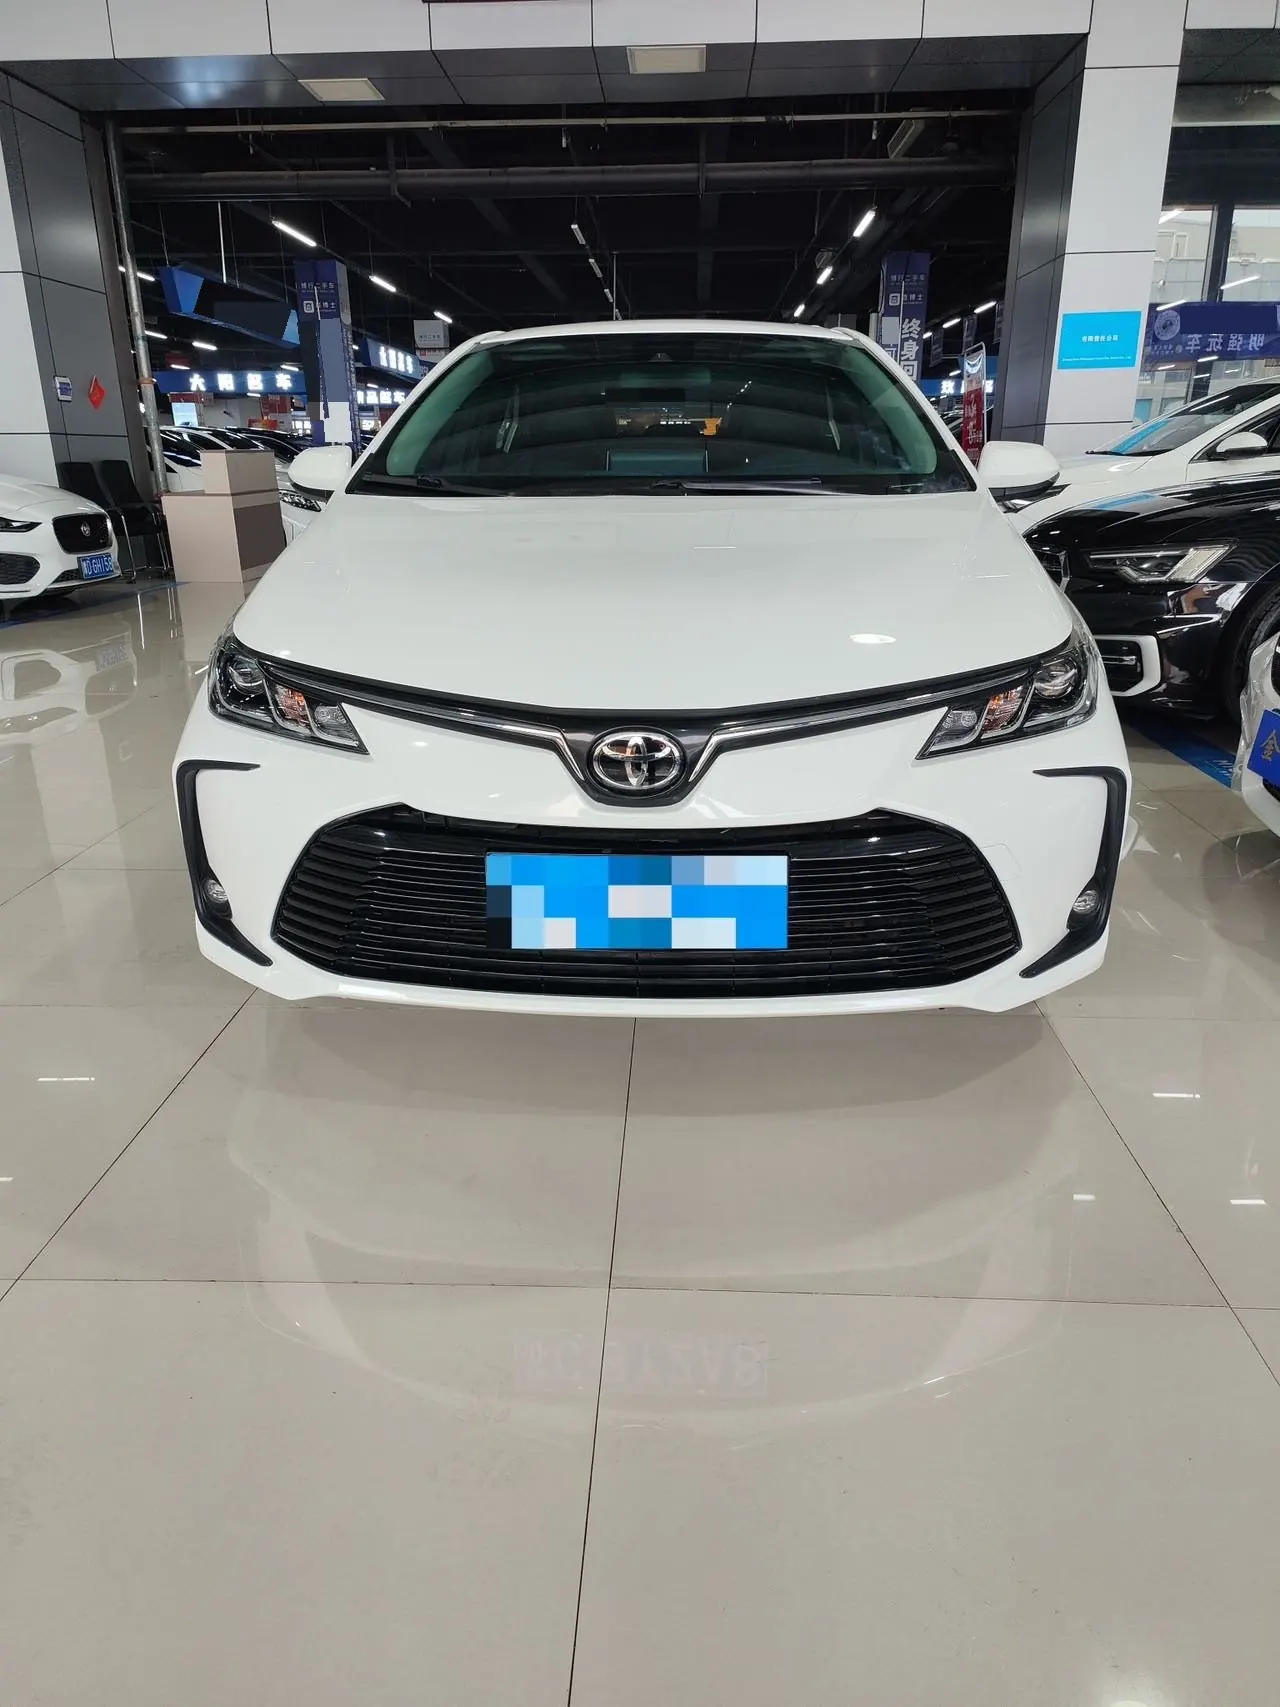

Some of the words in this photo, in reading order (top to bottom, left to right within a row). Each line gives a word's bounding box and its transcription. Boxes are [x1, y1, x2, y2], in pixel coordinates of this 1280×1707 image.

[1082, 335, 1118, 343] 有限责任公司
